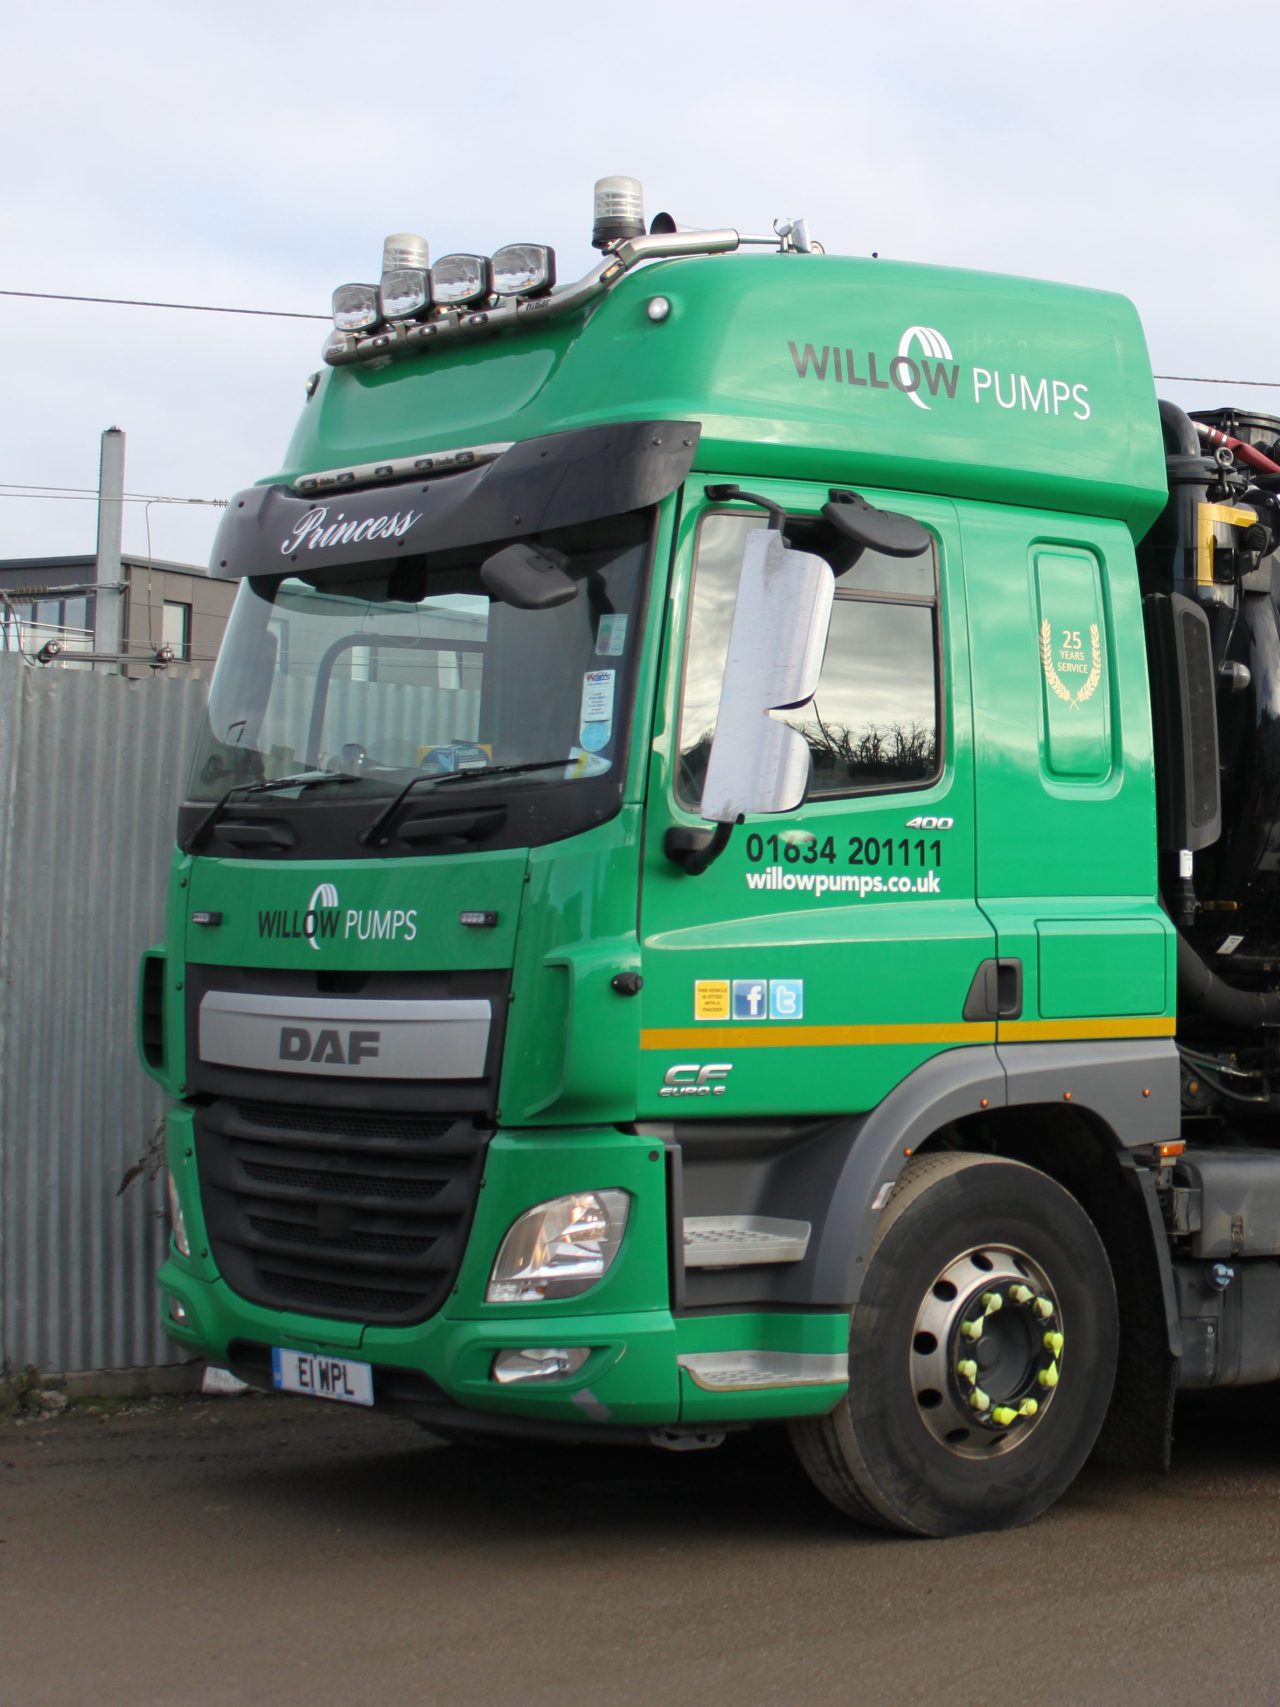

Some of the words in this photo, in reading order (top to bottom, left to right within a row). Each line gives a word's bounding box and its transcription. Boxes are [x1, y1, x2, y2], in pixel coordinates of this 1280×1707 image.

[787, 341, 960, 400] WILLOW
[973, 367, 1091, 421] PUMPS
[281, 507, 424, 555] Princess
[1062, 630, 1082, 649] 25
[1057, 662, 1089, 674] SERVICE
[1059, 650, 1085, 661] YEARS
[905, 817, 954, 830] 400
[746, 834, 837, 864] 01634
[849, 837, 942, 867] 201111
[746, 867, 941, 897] willowpumps.co.uk
[258, 910, 341, 939] WILLOW
[344, 910, 418, 940] PUMPS
[279, 1027, 381, 1065] DAF
[664, 1063, 733, 1085] CF
[659, 1086, 710, 1097] EURO
[711, 1086, 726, 1096] 6
